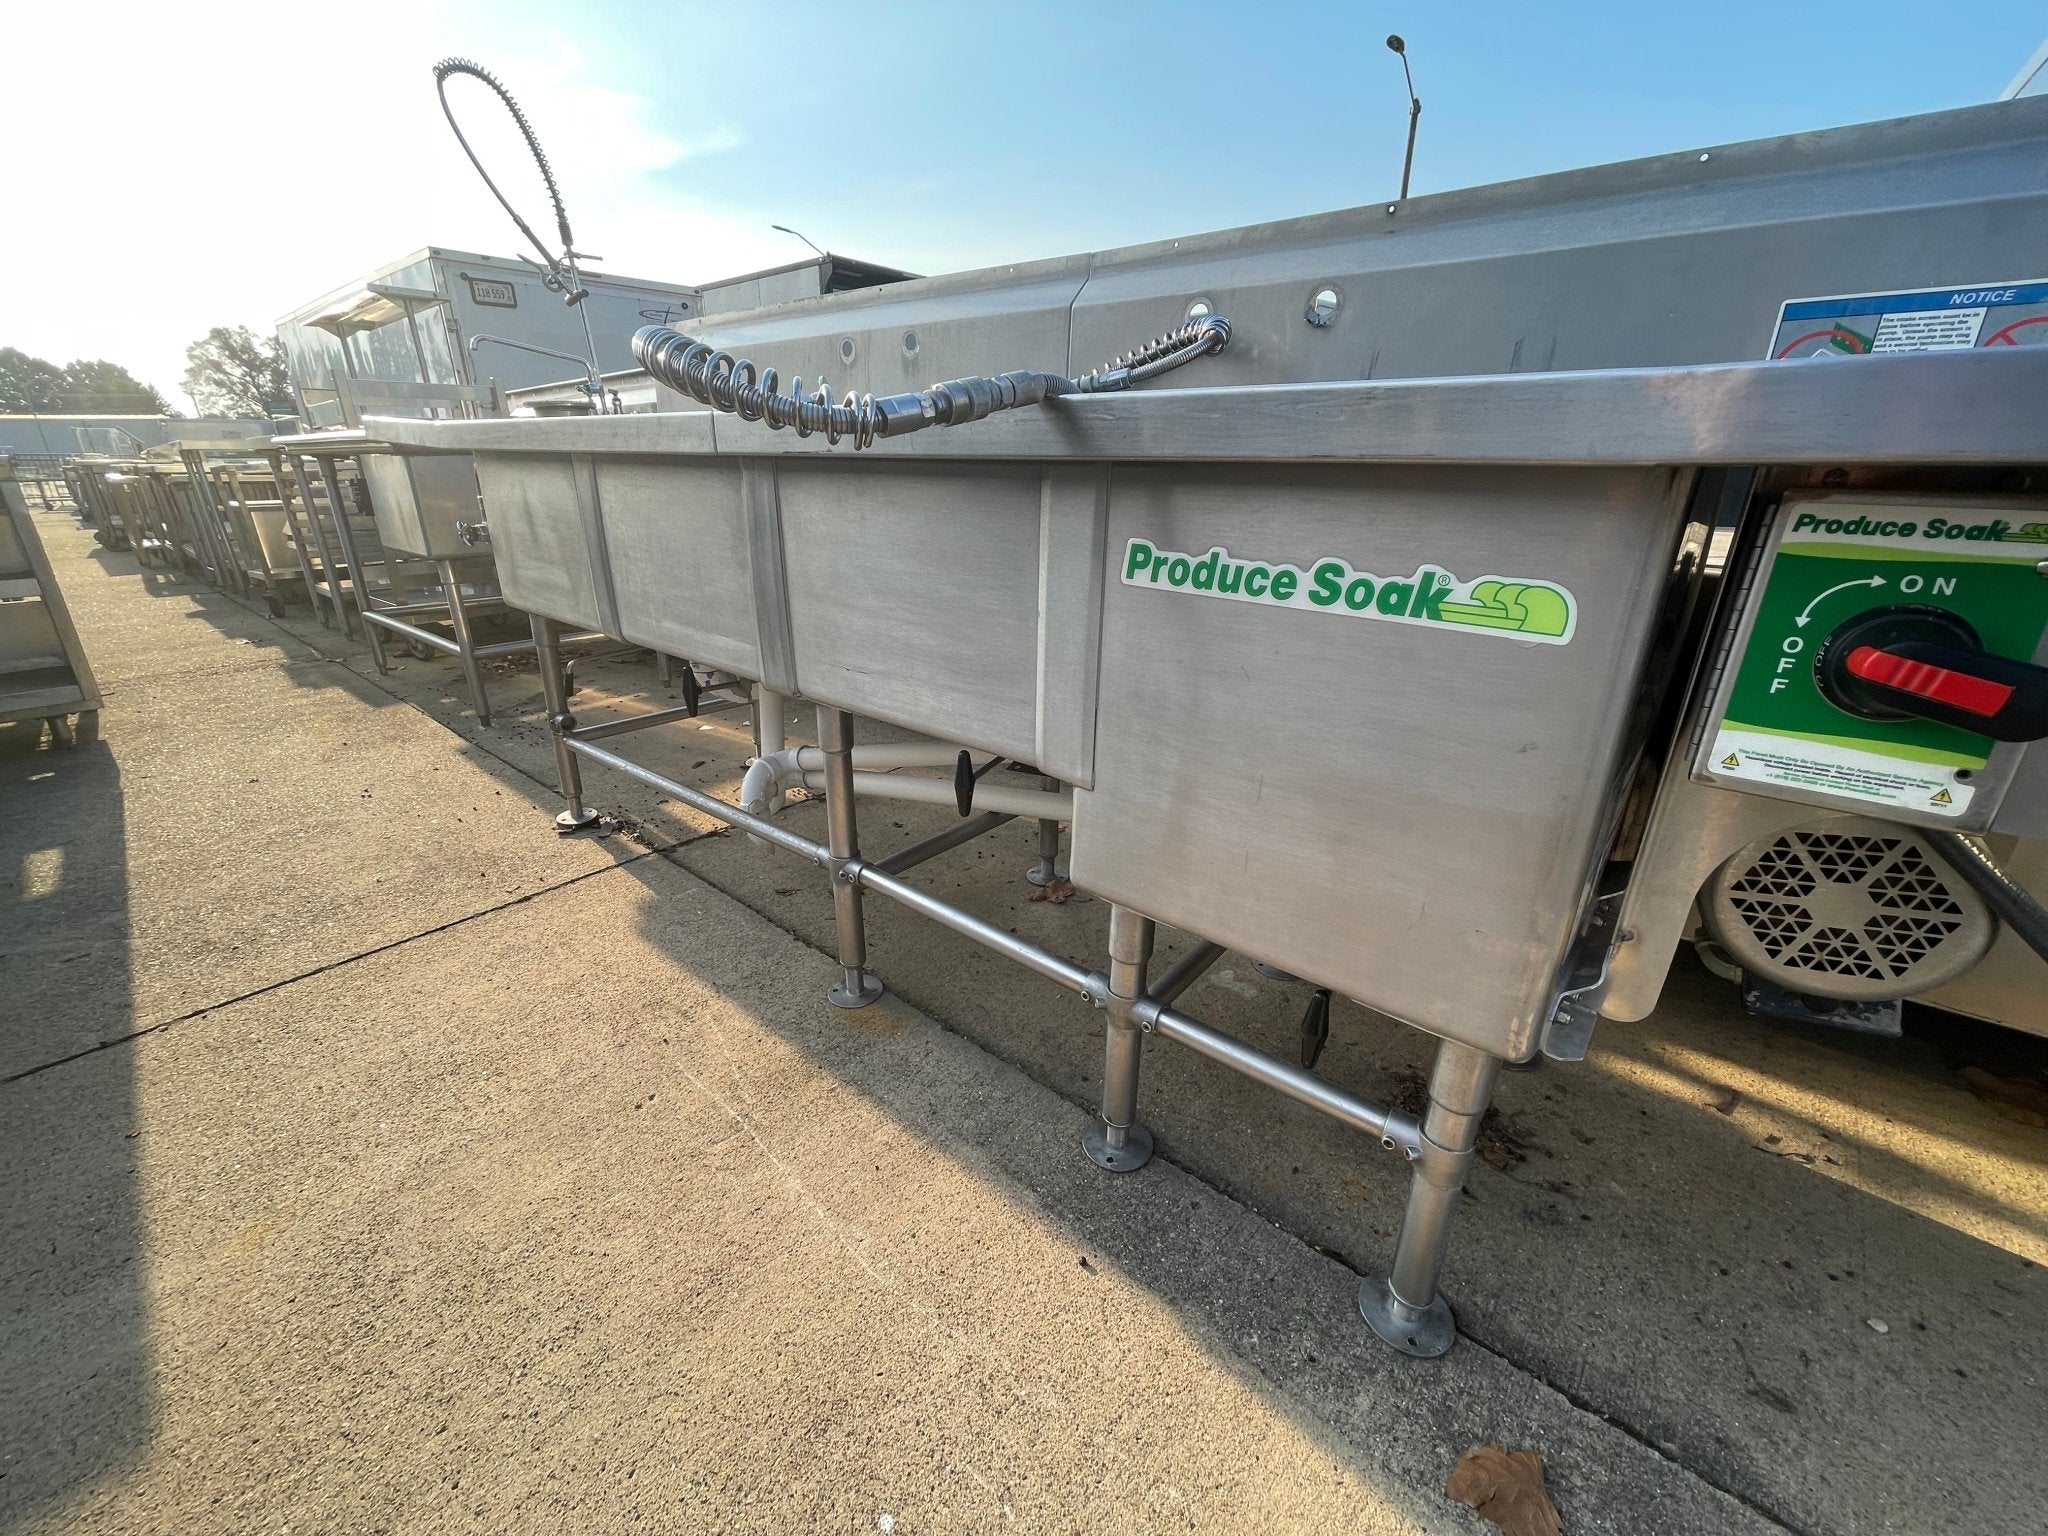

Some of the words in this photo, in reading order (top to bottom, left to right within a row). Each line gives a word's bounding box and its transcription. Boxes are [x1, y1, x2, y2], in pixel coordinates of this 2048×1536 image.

[1950, 289, 2016, 305] NOTICE
[1792, 514, 1917, 537] Produce
[1923, 518, 2011, 541] Soak
[1125, 543, 1297, 600] Produce
[1900, 575, 1957, 596] ON
